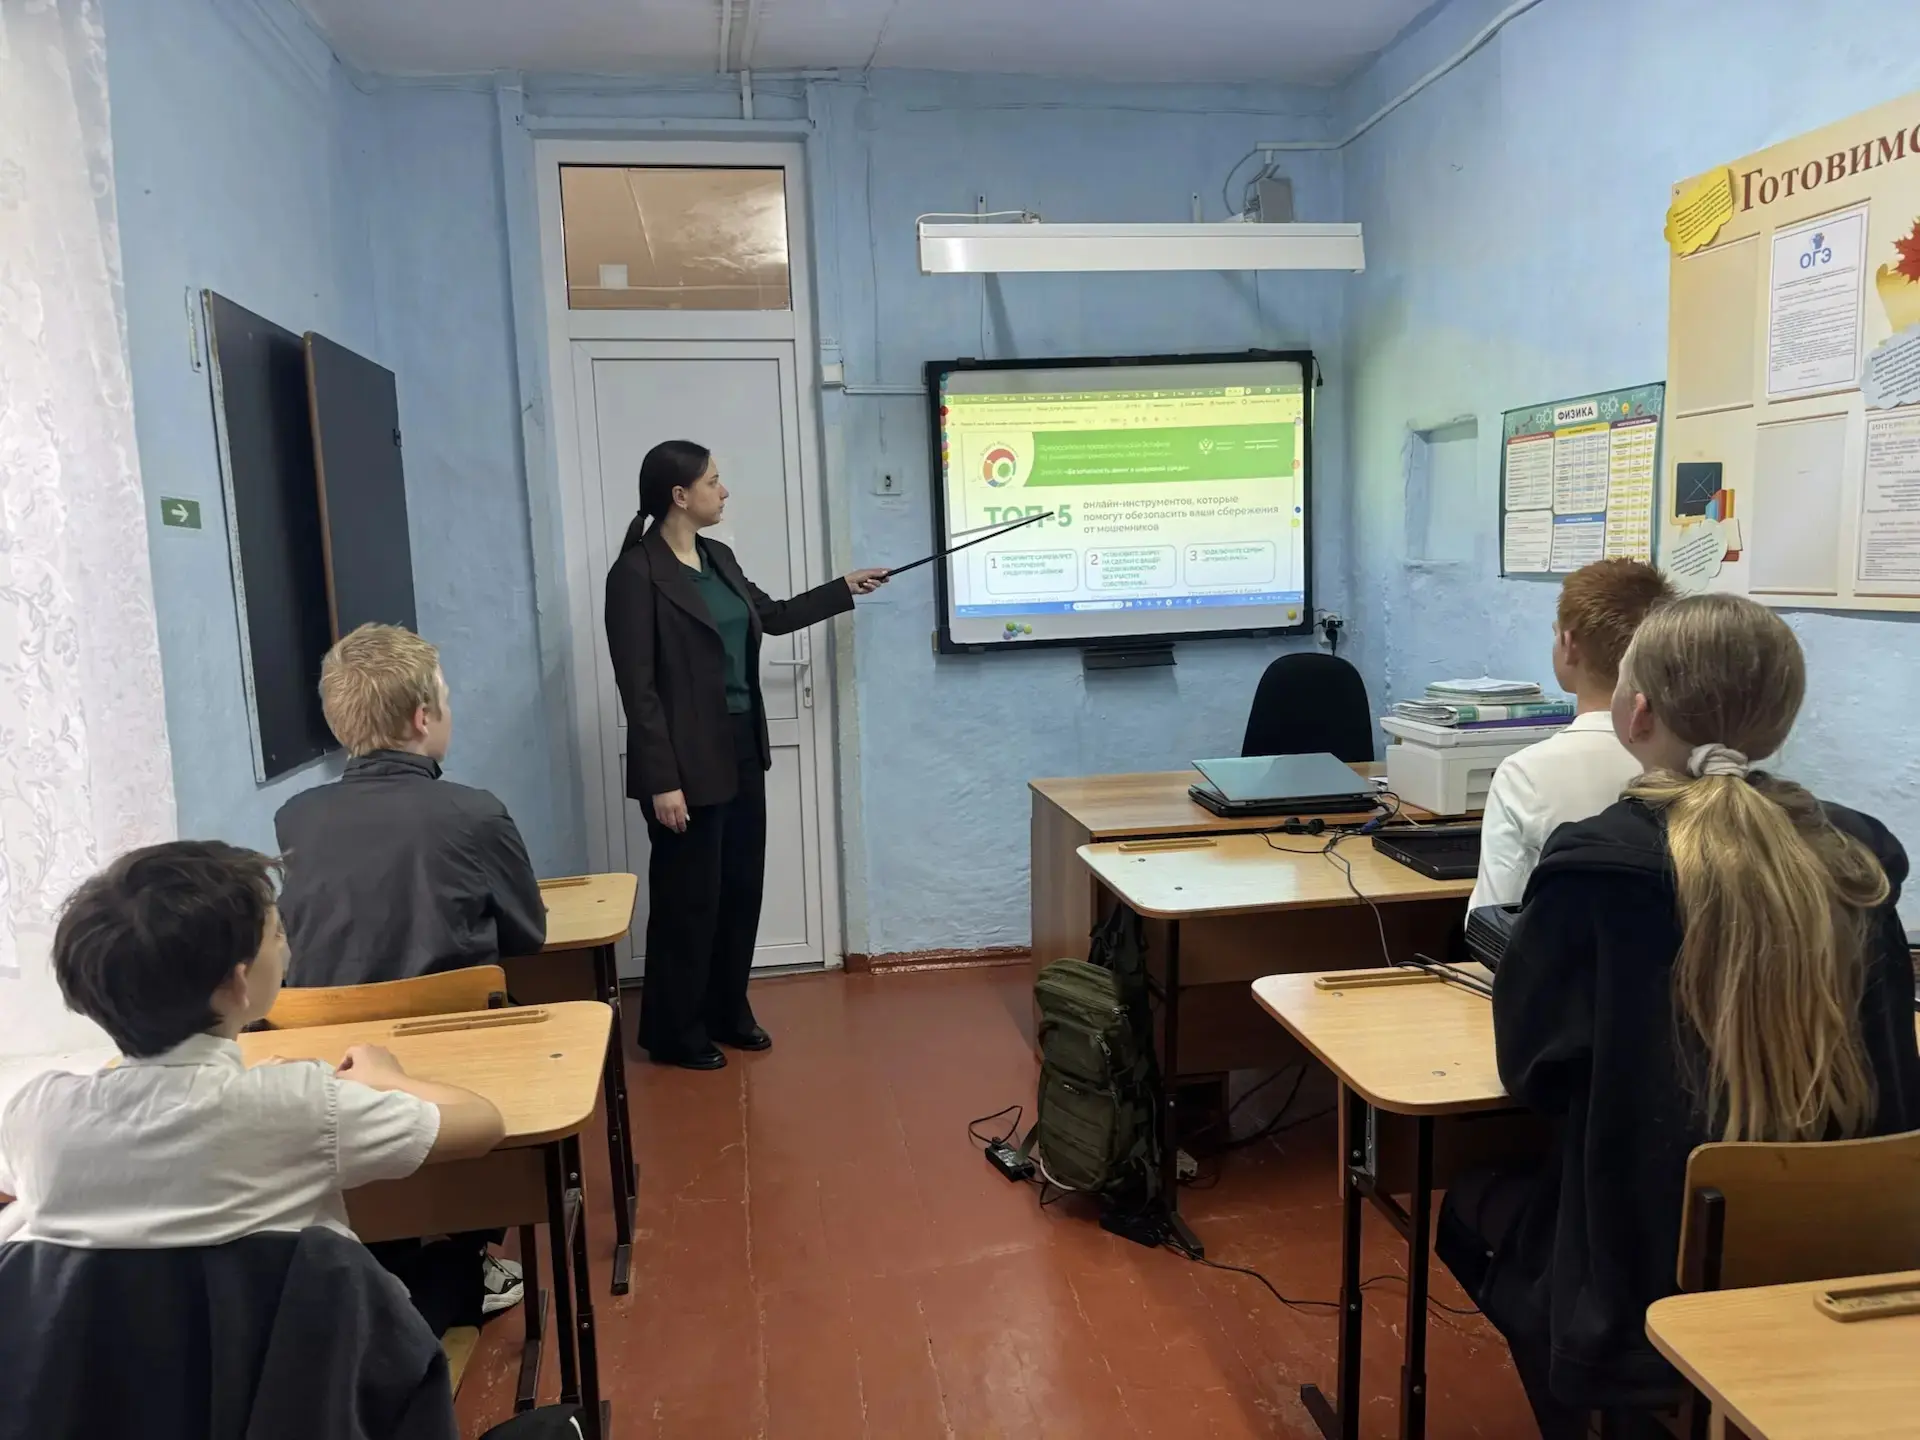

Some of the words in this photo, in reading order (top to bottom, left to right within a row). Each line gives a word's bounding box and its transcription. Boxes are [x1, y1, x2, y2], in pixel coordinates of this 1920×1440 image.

[1799, 247, 1833, 269] ОГЭ
[1557, 406, 1594, 420] ФИЗИКА
[1083, 498, 1195, 510] онлайн-инструментов,
[1196, 495, 1239, 506] которые
[984, 503, 1073, 529] ТОП-5
[1083, 511, 1123, 522] помогут
[1125, 509, 1188, 520] обезопасить
[1189, 508, 1215, 517] ваши
[1217, 505, 1280, 517] сбережения
[1097, 523, 1160, 533] мошенников
[1090, 554, 1099, 566] 2
[1189, 550, 1198, 561] 3
[990, 558, 998, 569] 1
